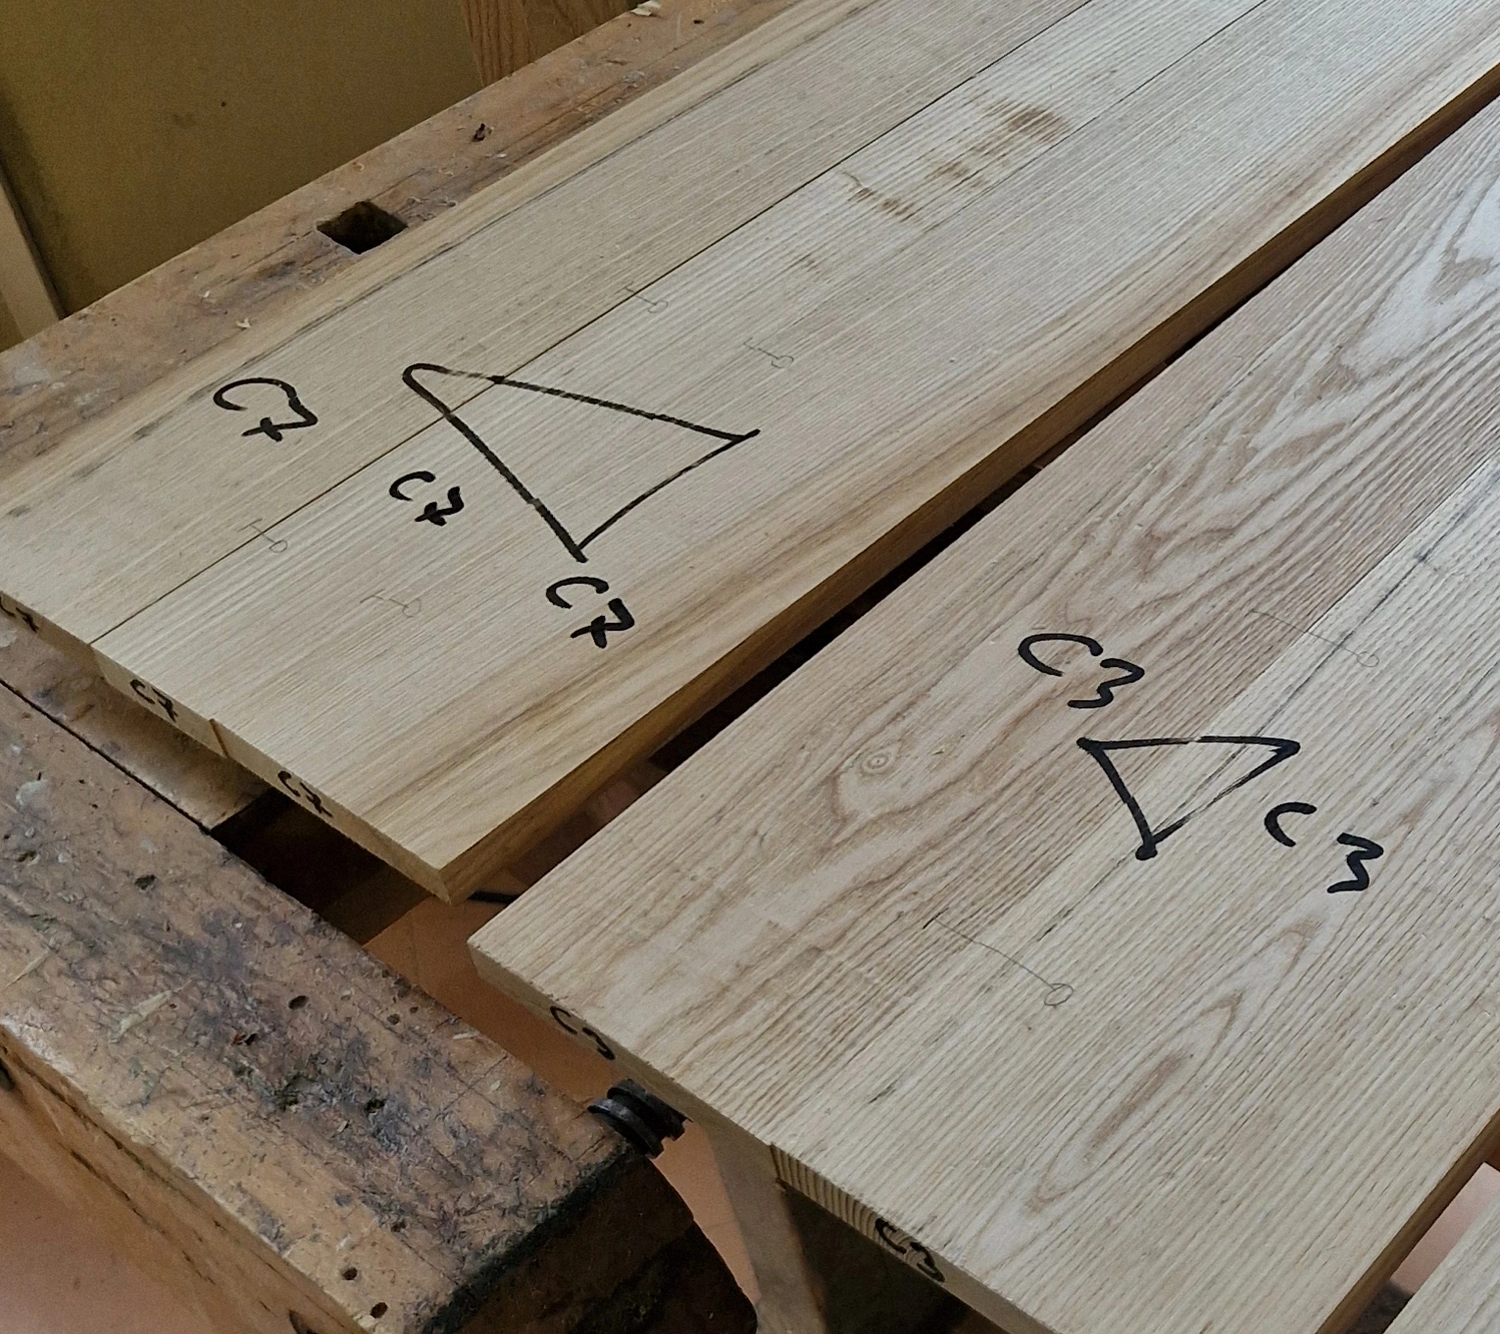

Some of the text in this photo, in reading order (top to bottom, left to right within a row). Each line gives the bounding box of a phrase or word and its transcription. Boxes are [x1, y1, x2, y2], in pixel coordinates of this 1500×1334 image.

[212, 375, 318, 443] C7
[388, 470, 464, 526] C7
[545, 575, 635, 649] C7
[1018, 632, 1145, 709] C3
[1264, 801, 1384, 894] C3
